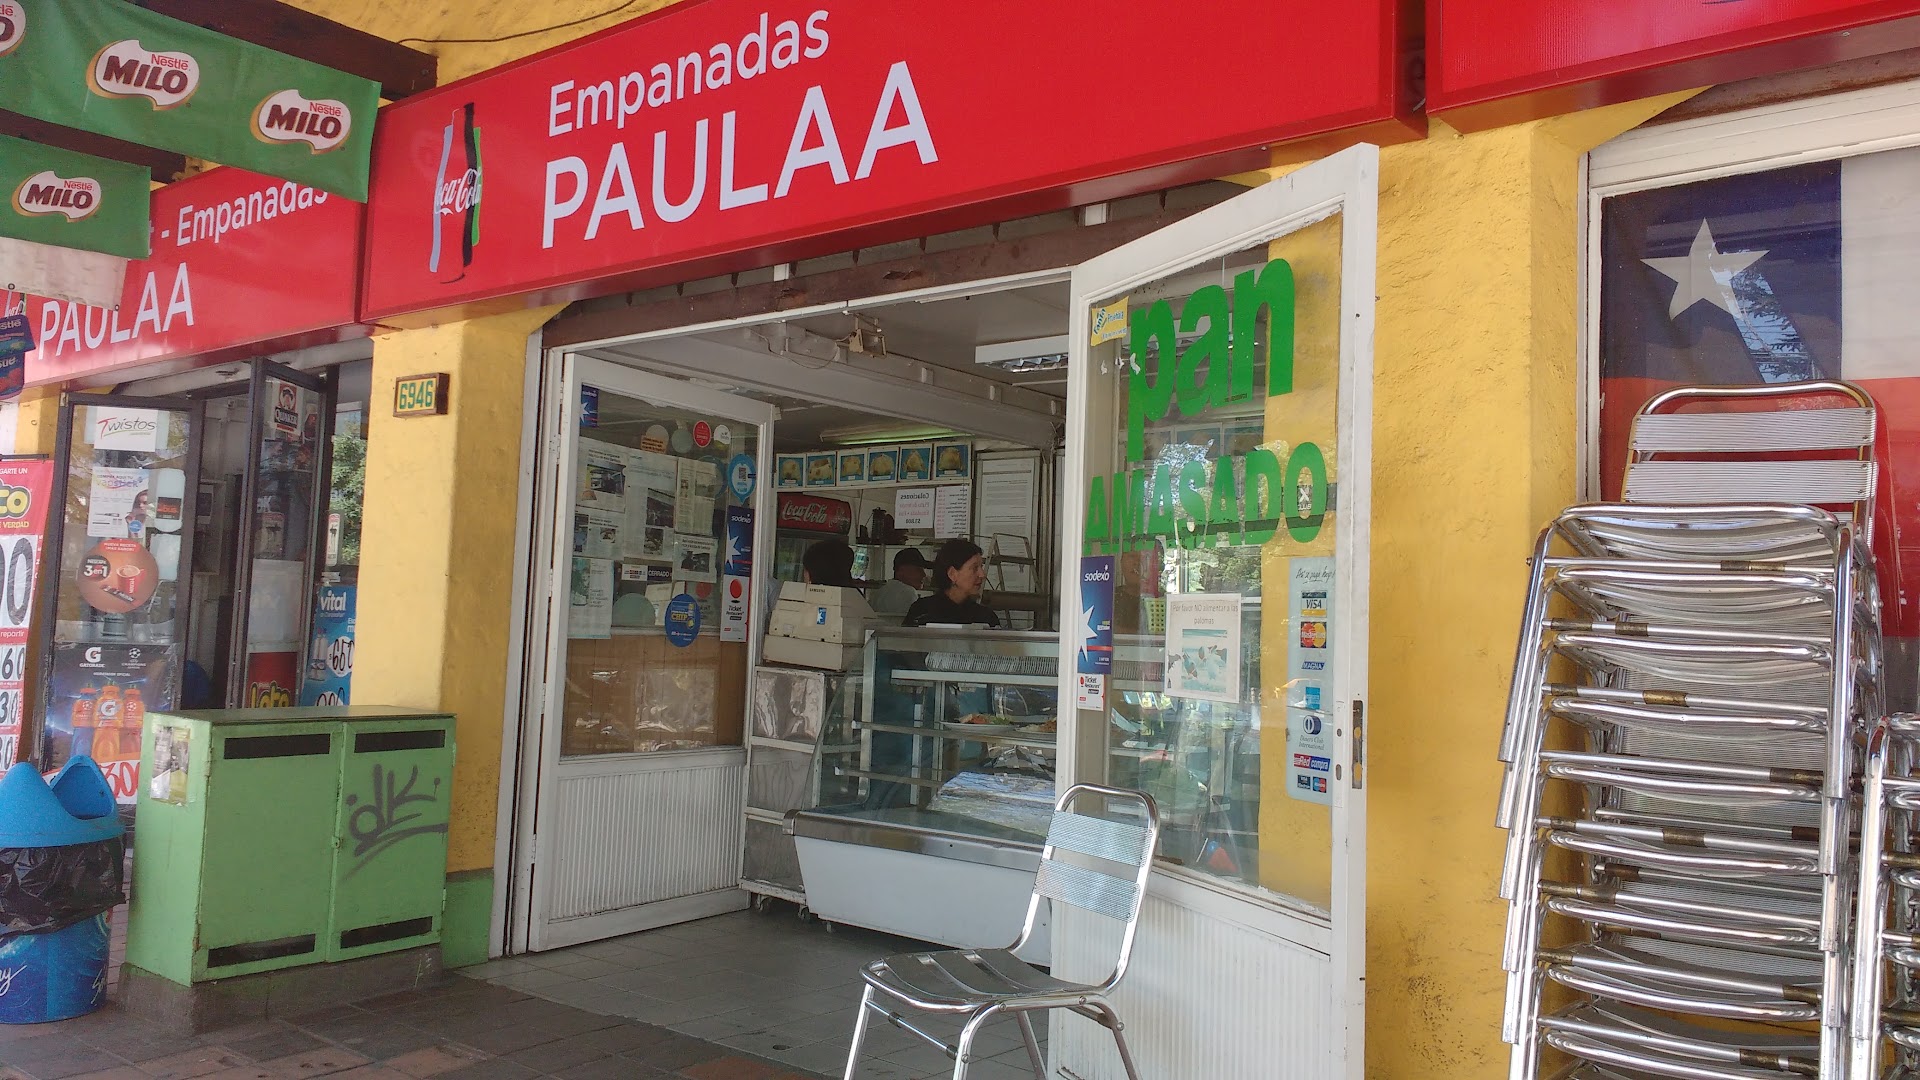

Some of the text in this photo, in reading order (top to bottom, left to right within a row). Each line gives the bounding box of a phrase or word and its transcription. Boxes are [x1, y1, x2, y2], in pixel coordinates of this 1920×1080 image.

[151, 53, 189, 71] Nestlé
[102, 55, 188, 94] MILO
[548, 9, 830, 138] Empanadas
[309, 101, 342, 117] Nestlé
[265, 104, 342, 139] MILO
[542, 60, 938, 249] PAULAA
[63, 179, 93, 192] Nestlé
[25, 183, 93, 210] MILO
[1126, 258, 1295, 462] pan
[399, 380, 433, 409] 6946
[97, 417, 156, 439] Twistos
[1082, 441, 1327, 557] AMASADO
[731, 514, 752, 524] sodexo
[782, 500, 829, 524] Coca-Cola
[648, 569, 670, 578] CERRADO
[1084, 569, 1110, 582] sodexo
[320, 590, 347, 611] vital
[1181, 604, 1193, 612] favor
[1194, 604, 1203, 612] NO
[1306, 599, 1322, 609] VISA
[1194, 617, 1215, 625] palomas
[1299, 741, 1325, 751] International
[1314, 736, 1324, 744] Club
